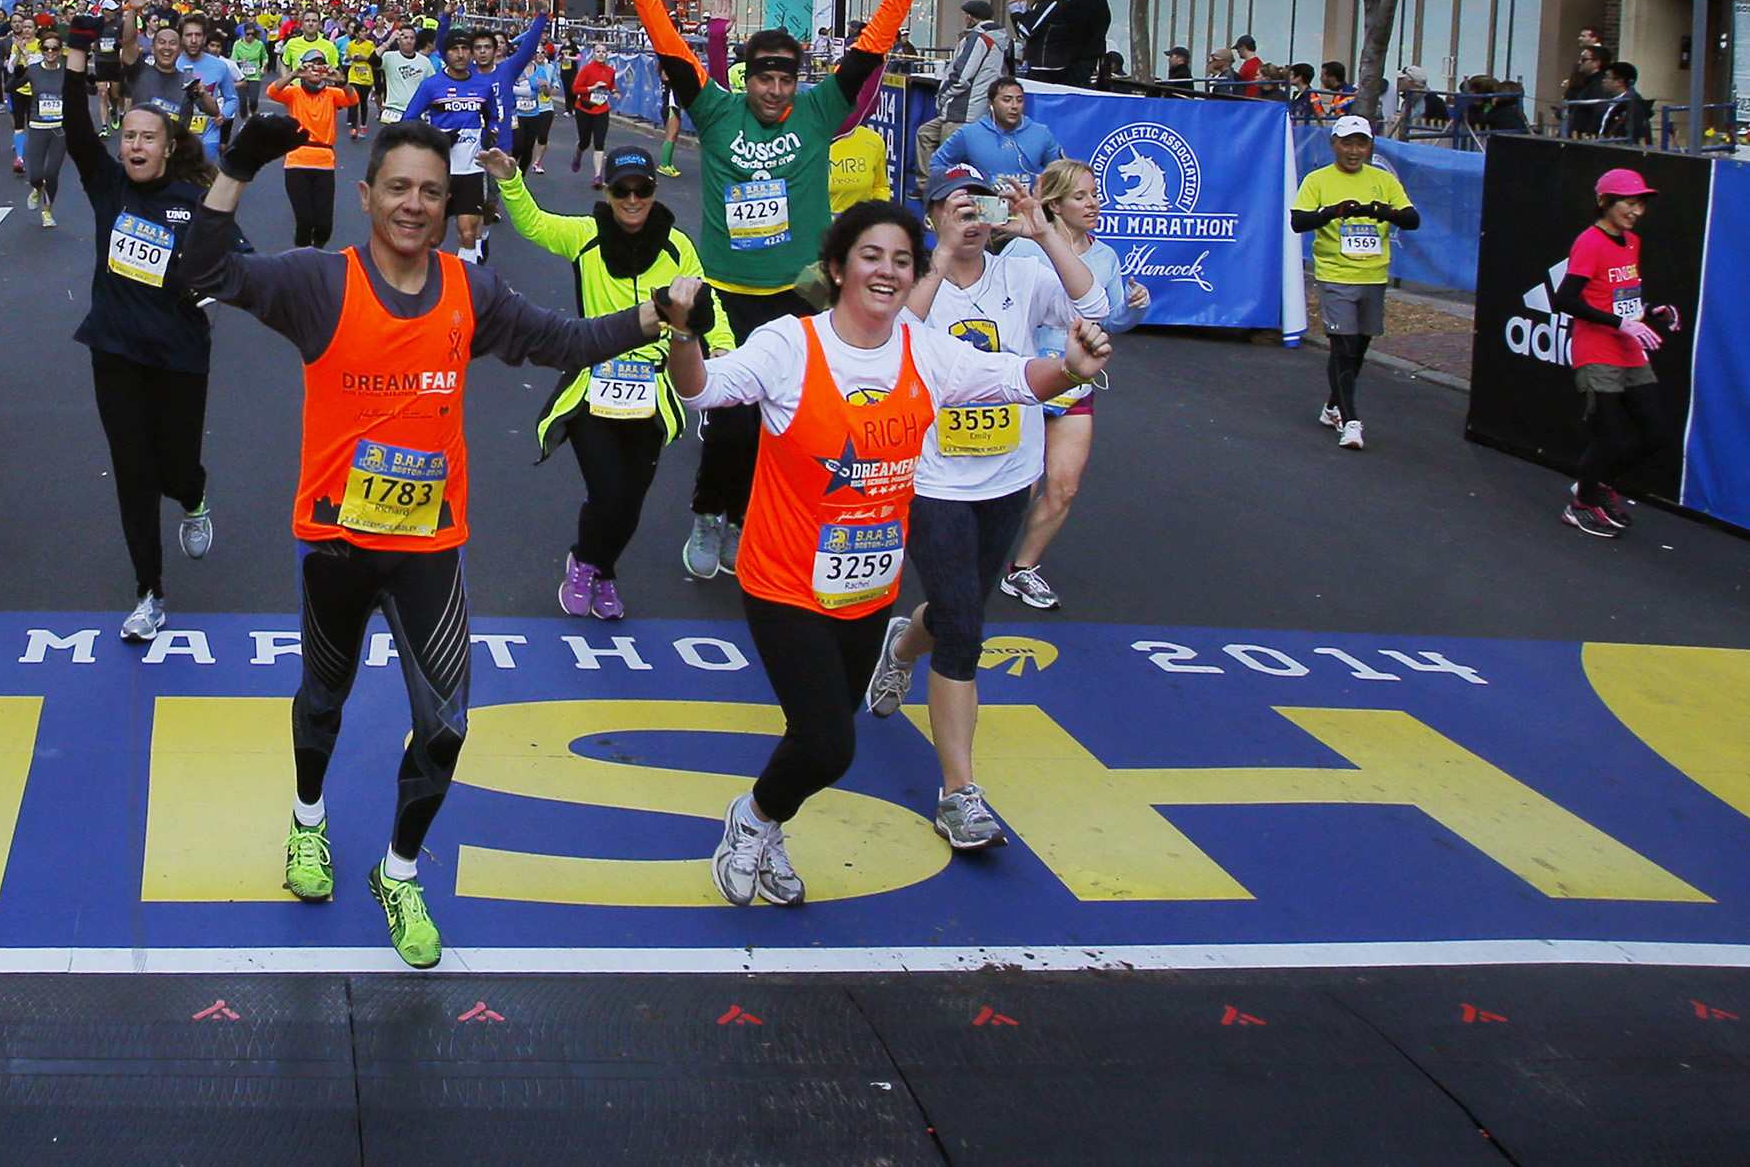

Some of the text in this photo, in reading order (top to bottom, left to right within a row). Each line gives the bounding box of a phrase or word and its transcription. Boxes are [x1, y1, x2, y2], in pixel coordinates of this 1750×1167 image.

[829, 157, 867, 175] MR8
[1105, 125, 1158, 158] ATHLETIC
[1158, 128, 1199, 207] ASSOCIATION
[166, 210, 191, 220] UNO
[733, 200, 779, 221] 4229
[1125, 215, 1235, 237] MARATHON
[116, 237, 161, 264] 4150
[764, 234, 786, 246] 4229
[1347, 238, 1377, 248] 1569
[1120, 244, 1214, 292] Hancock
[1506, 313, 1574, 367] adi
[342, 371, 457, 391] DREAMFAR
[600, 380, 647, 400] 7572
[948, 407, 1011, 431] 3553
[863, 416, 919, 449] RICH
[969, 432, 992, 441] Emily
[852, 455, 921, 479] DREAMFA
[362, 476, 434, 506] 1783
[826, 553, 893, 580] 3259
[18, 628, 750, 671] MARATHO
[1131, 638, 1489, 685] 2014
